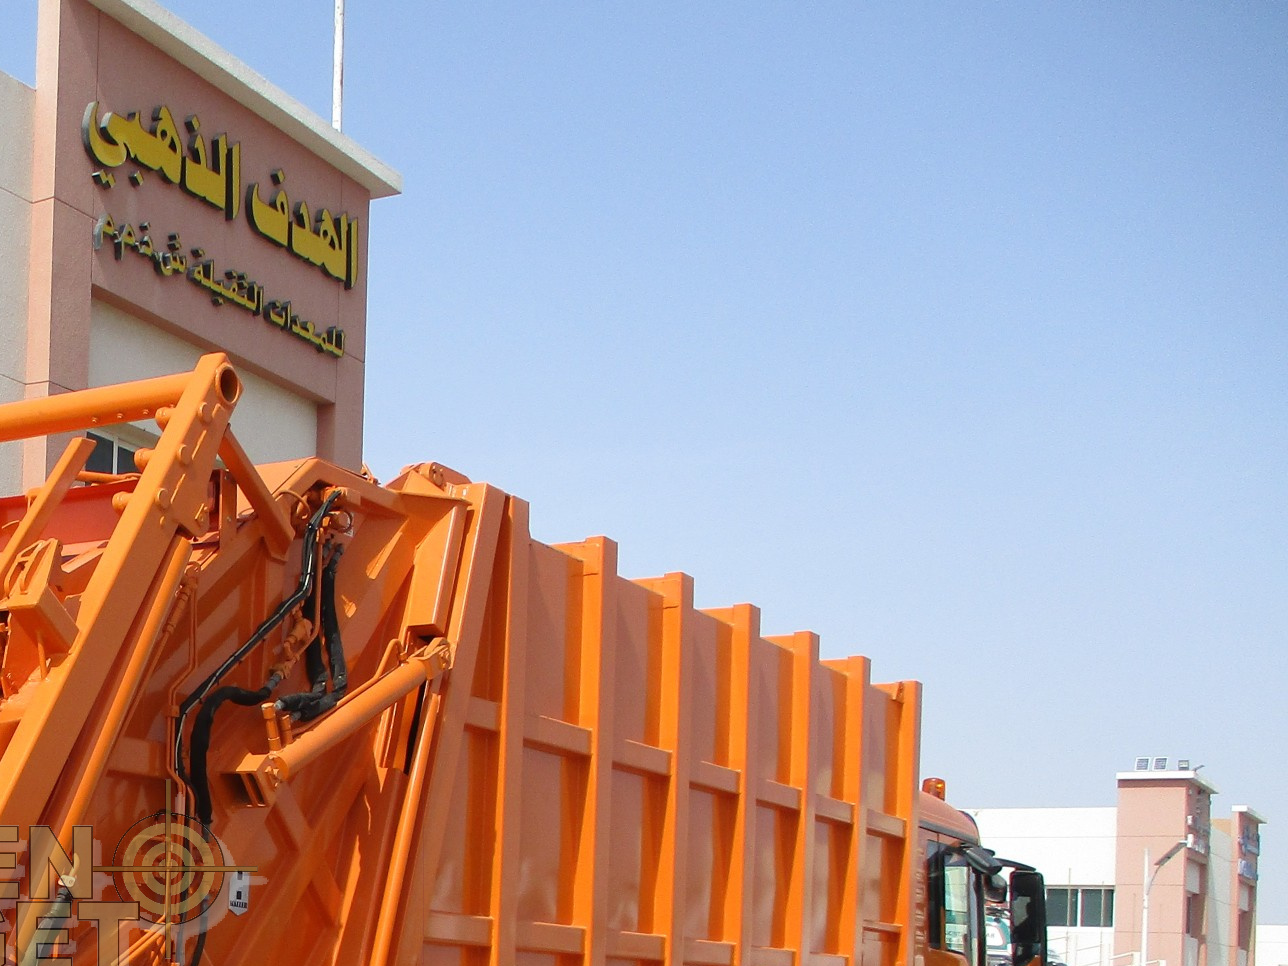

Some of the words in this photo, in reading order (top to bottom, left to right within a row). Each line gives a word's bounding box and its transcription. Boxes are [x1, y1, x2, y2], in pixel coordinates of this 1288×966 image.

[81, 100, 241, 221] الذهبي
[245, 167, 359, 291] الهدف
[186, 247, 264, 316] الثقيلة
[264, 300, 346, 358] للمعدات
